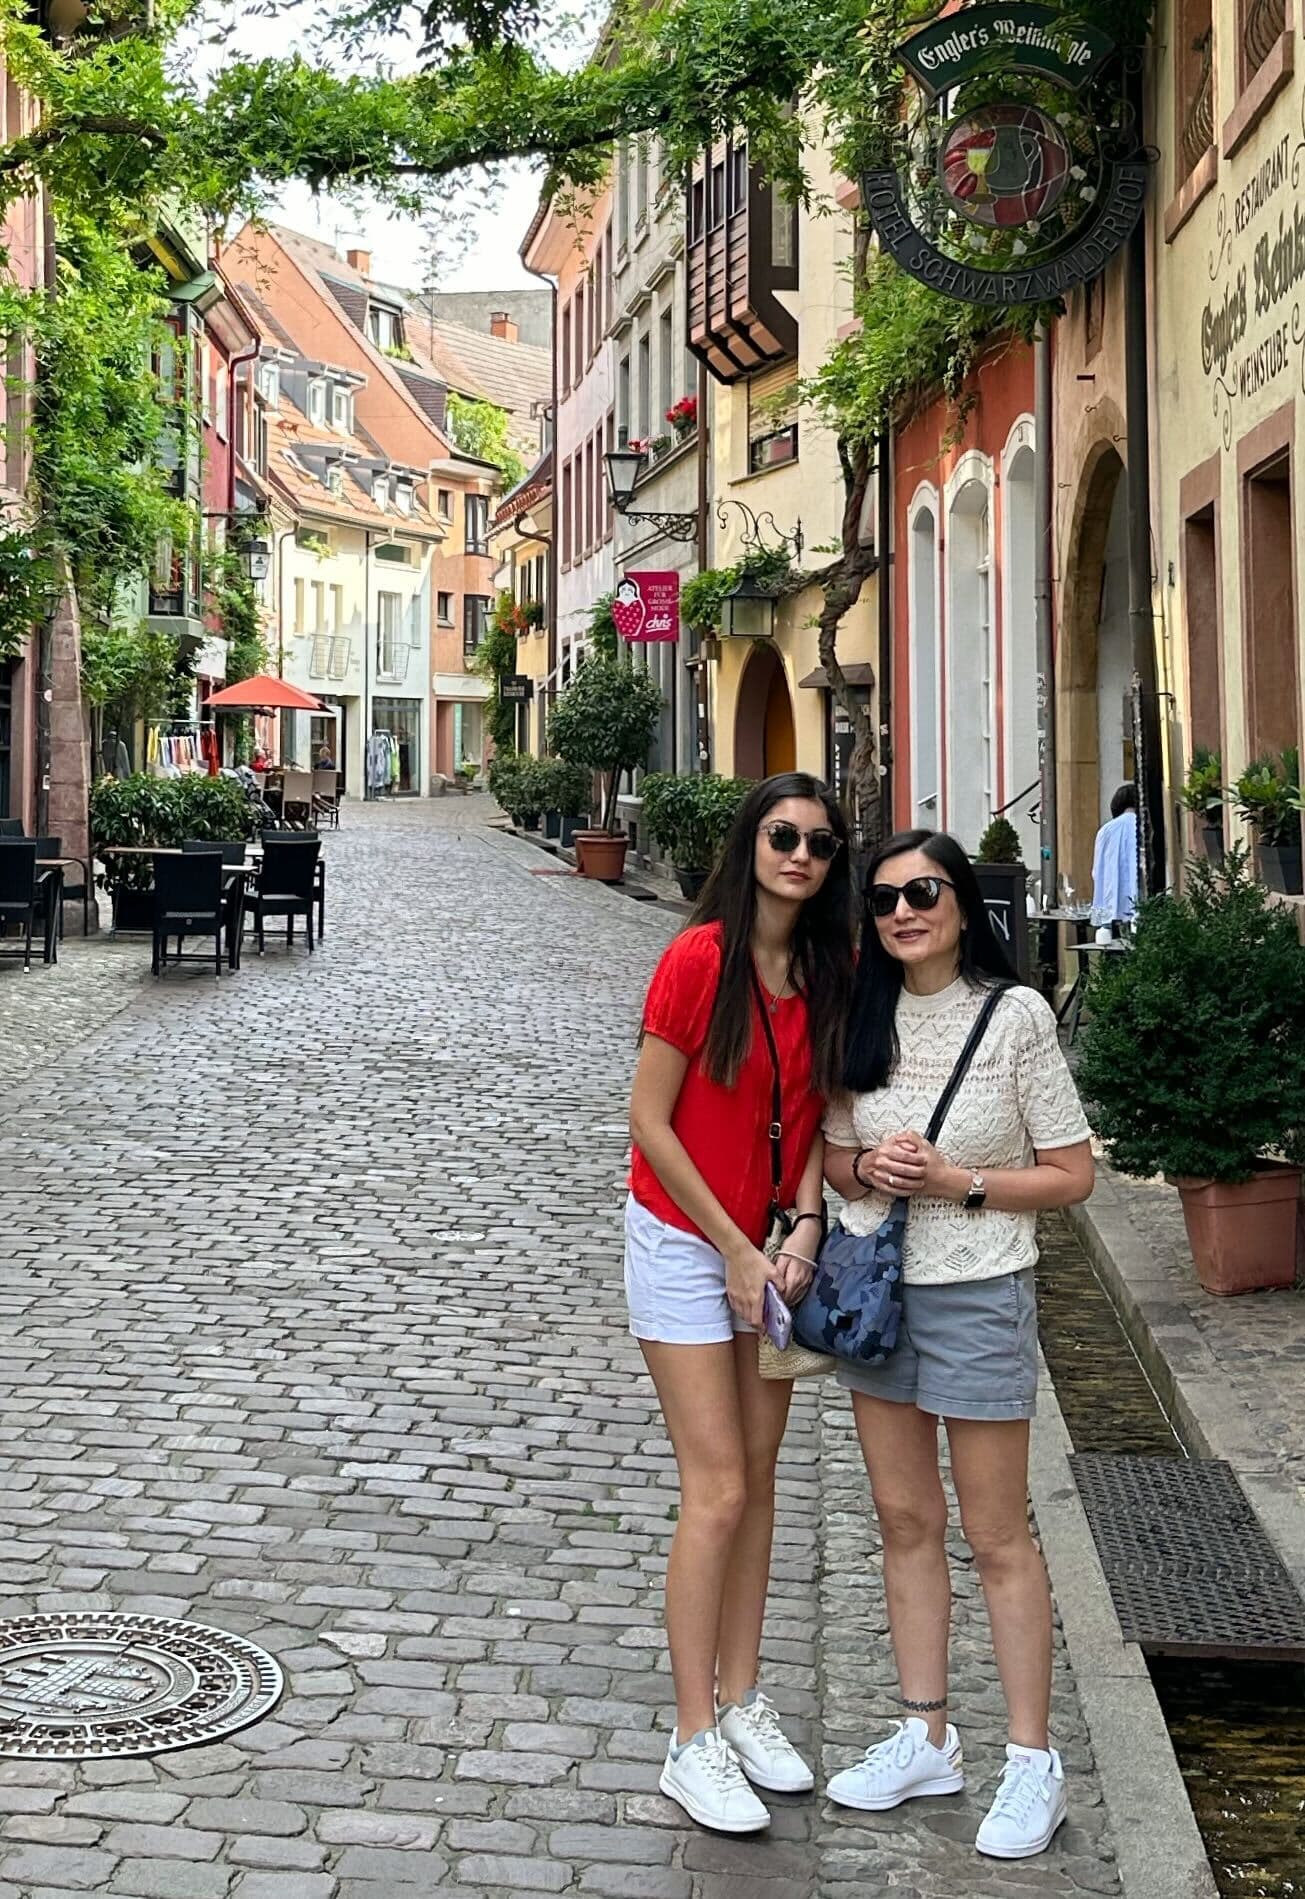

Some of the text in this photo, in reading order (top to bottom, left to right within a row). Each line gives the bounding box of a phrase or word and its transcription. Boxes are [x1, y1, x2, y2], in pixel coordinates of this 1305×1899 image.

[917, 23, 990, 70] Engler's
[866, 172, 912, 253] HOTEL
[1235, 133, 1290, 237] RESTAURANT
[1240, 321, 1289, 404] WEINSTUBE
